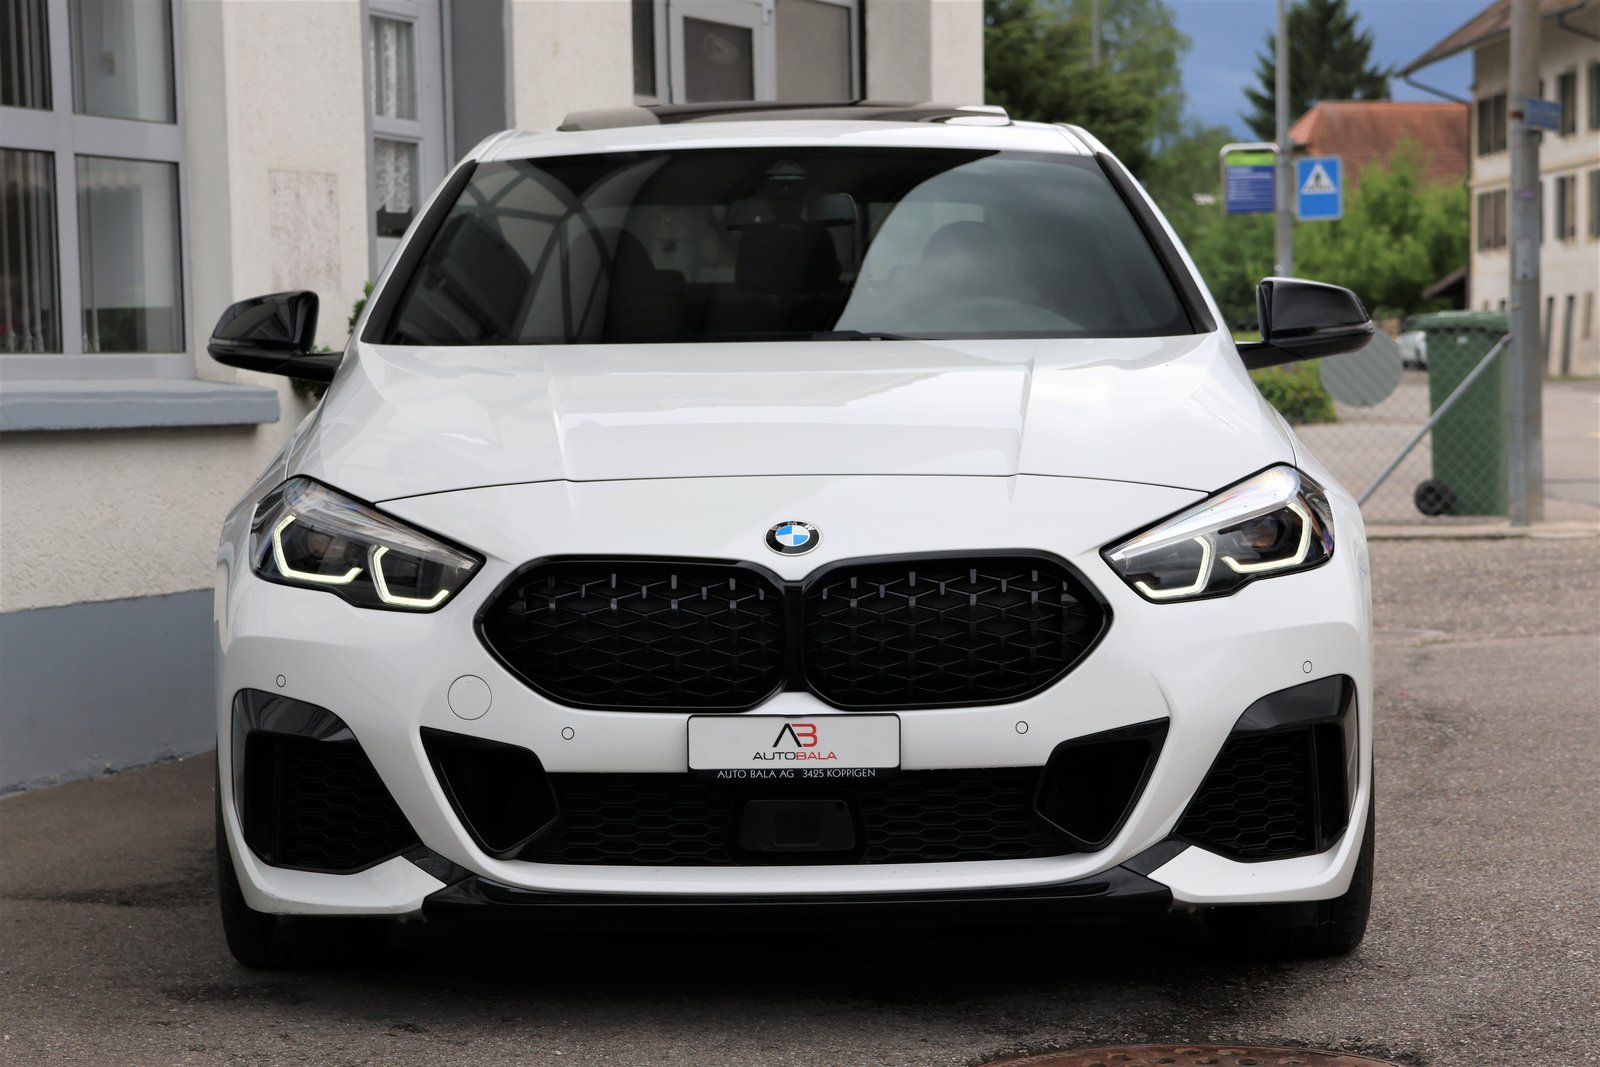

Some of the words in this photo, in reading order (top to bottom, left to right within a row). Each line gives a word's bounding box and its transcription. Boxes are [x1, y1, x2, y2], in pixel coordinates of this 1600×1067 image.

[717, 770, 747, 779] AUTO
[750, 769, 777, 779] BALA
[779, 769, 795, 778] AG
[802, 769, 825, 778] 3425
[826, 768, 876, 778] KOPPIGEN
